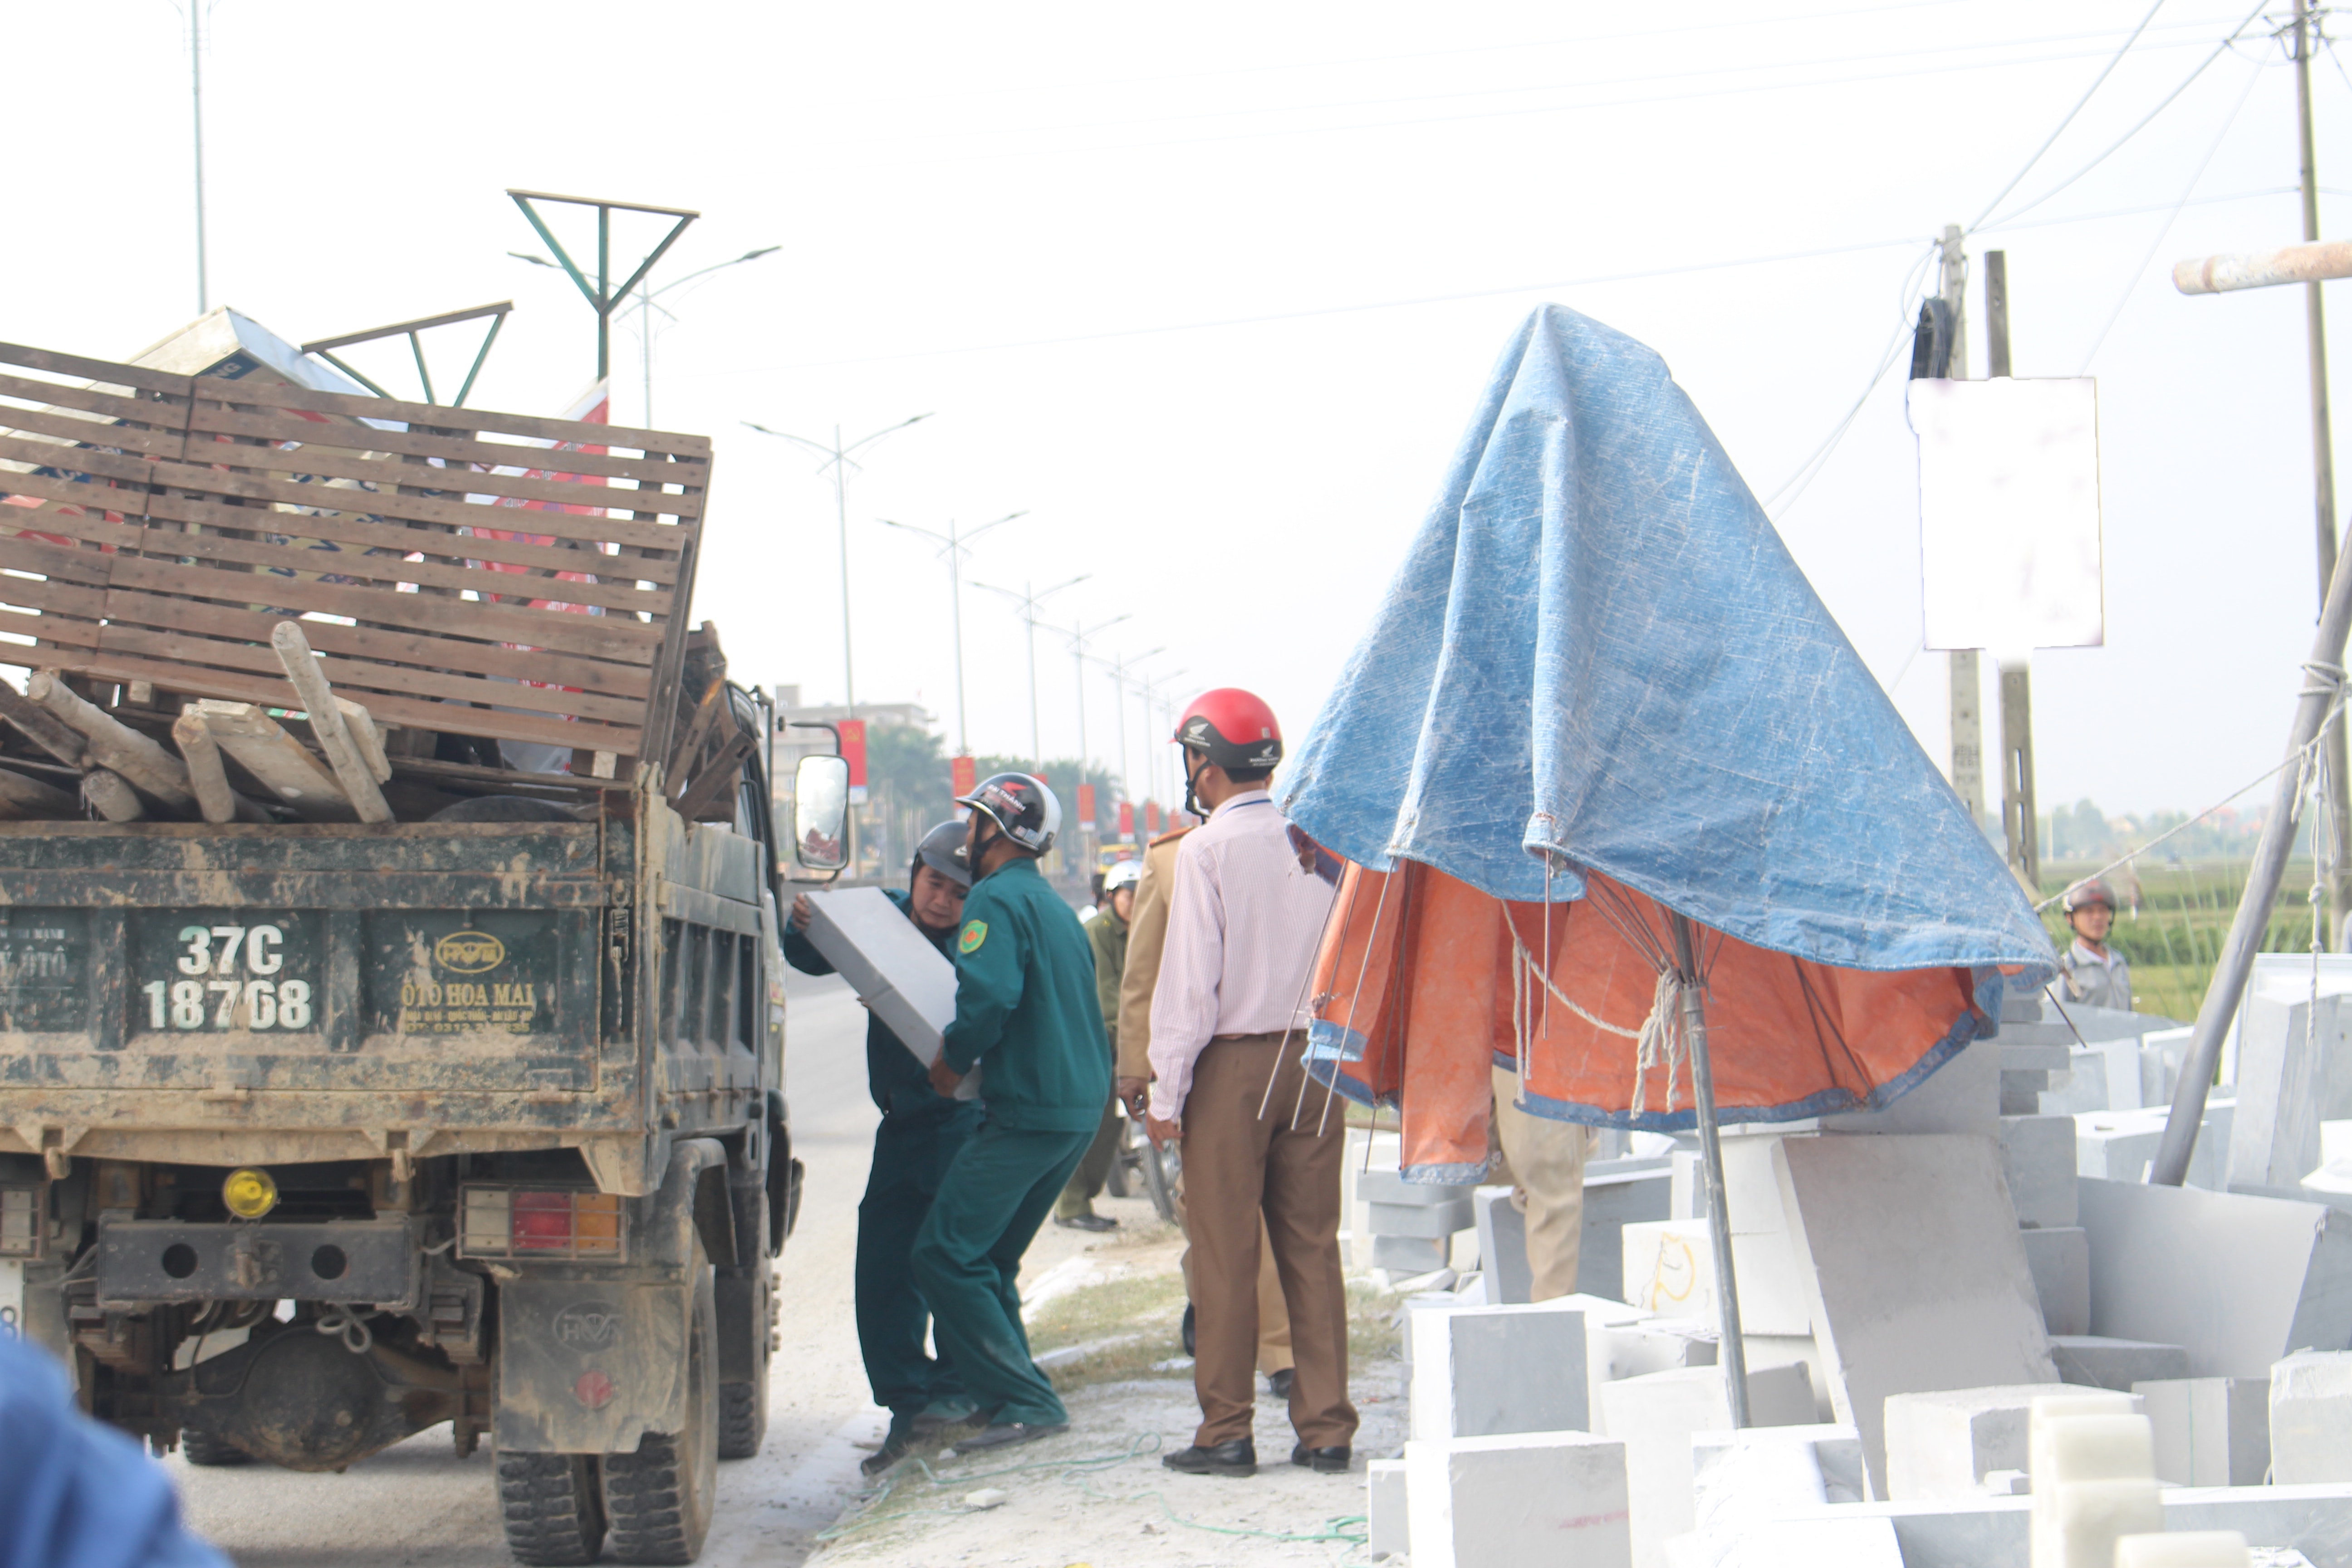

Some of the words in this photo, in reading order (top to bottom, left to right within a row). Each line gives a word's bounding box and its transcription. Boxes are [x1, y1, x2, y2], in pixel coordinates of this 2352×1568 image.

[177, 925, 283, 975] 37C
[142, 979, 311, 1029] 18768
[445, 983, 489, 1007] HOA
[492, 983, 534, 1007] MAI
